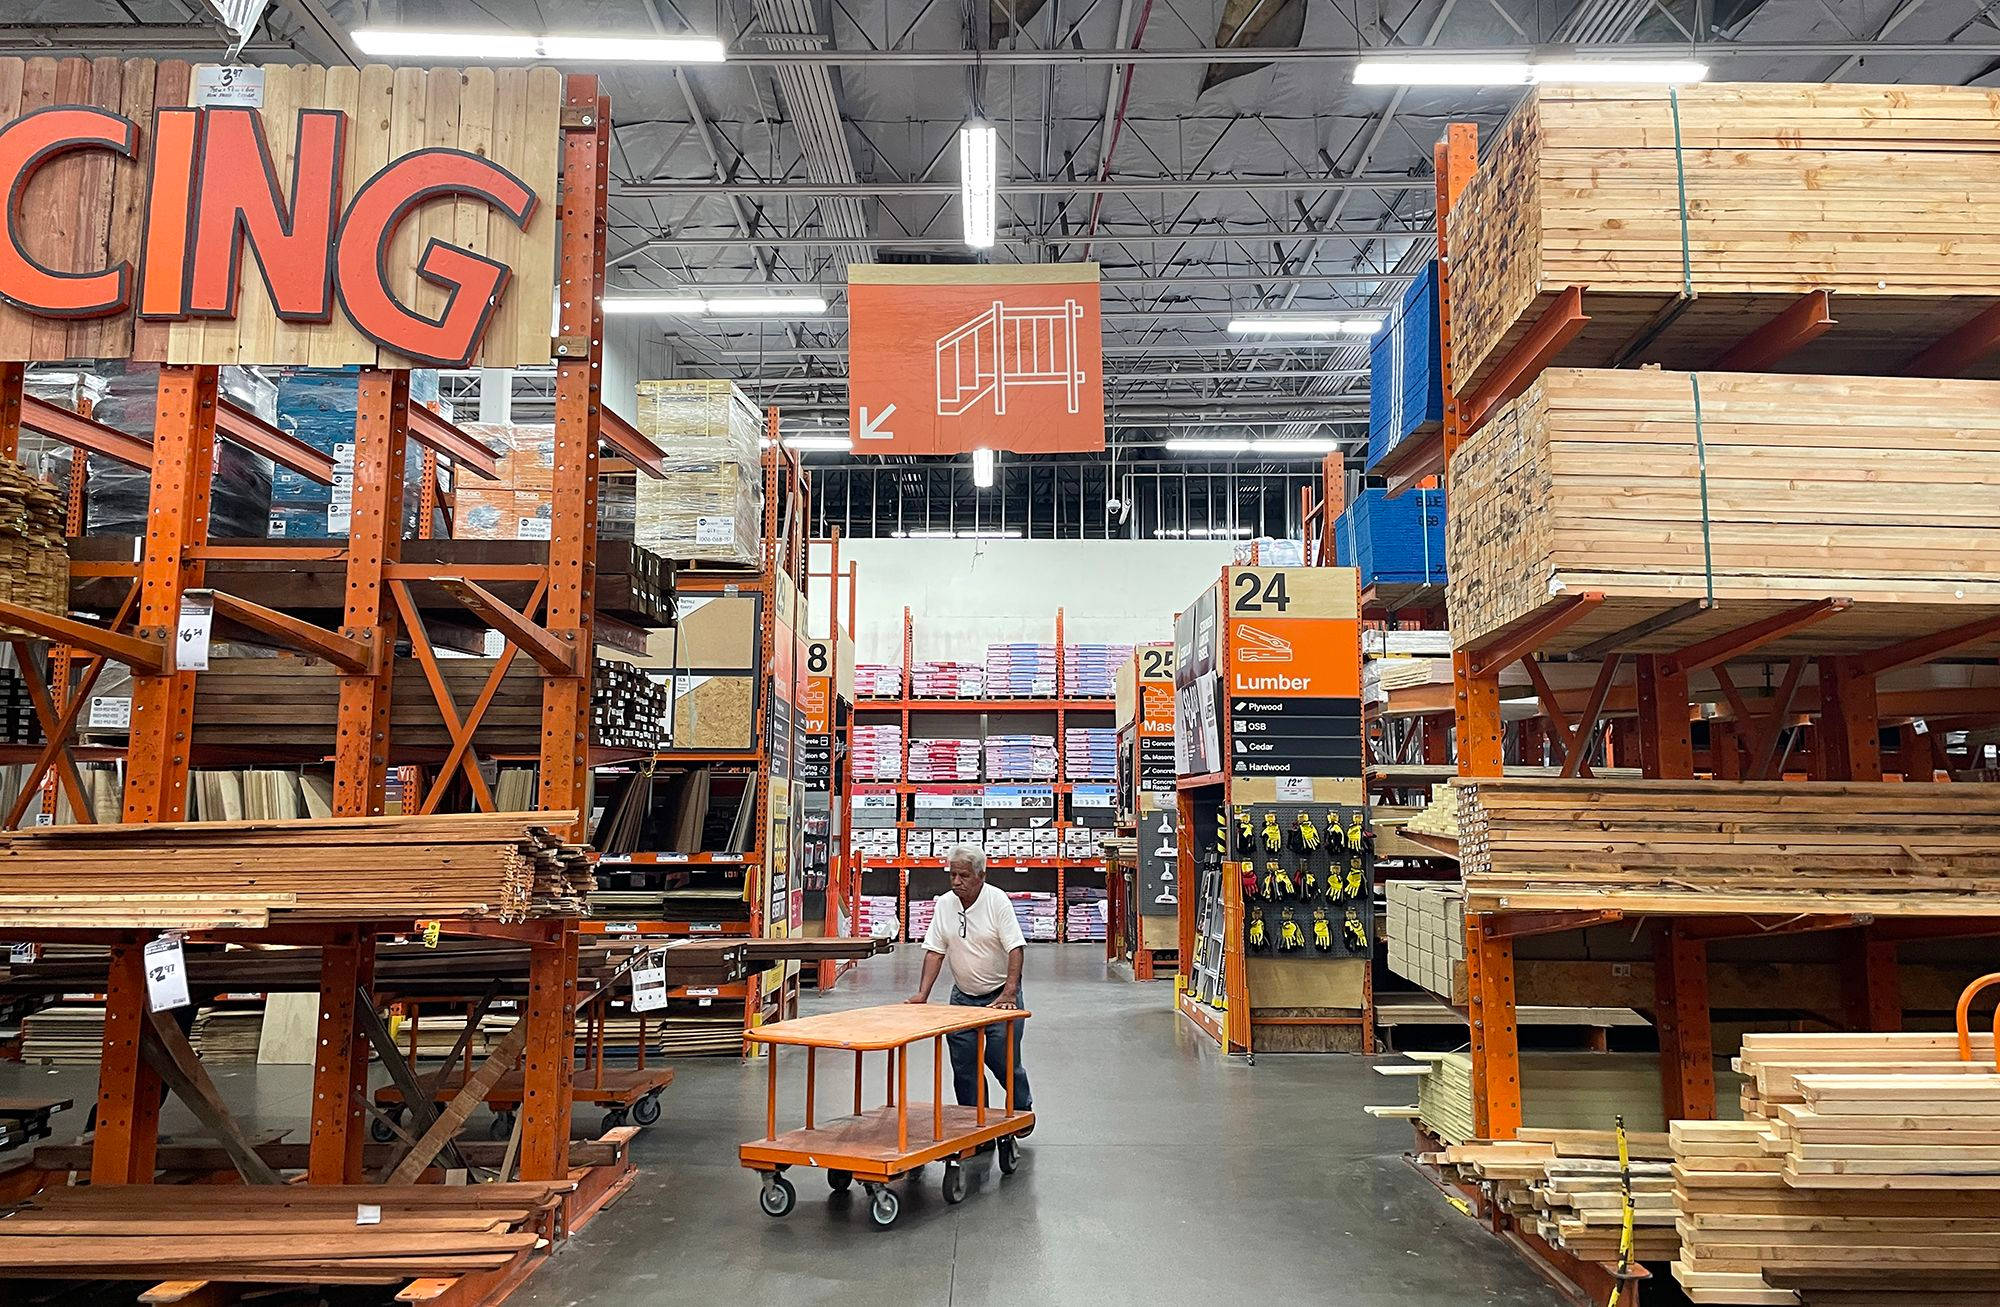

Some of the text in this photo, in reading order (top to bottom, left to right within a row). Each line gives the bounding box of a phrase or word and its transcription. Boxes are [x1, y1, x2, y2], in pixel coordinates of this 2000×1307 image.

[0, 104, 540, 368] CING
[1234, 572, 1291, 612] 24
[807, 643, 828, 673] 8
[1143, 650, 1174, 679] 25
[1236, 673, 1311, 690] Lumber
[1248, 703, 1283, 712] Plywood
[1144, 720, 1176, 732] Mas
[1248, 722, 1267, 731] OSB
[1248, 742, 1274, 751] Cedar
[1248, 763, 1291, 771] Hardwood
